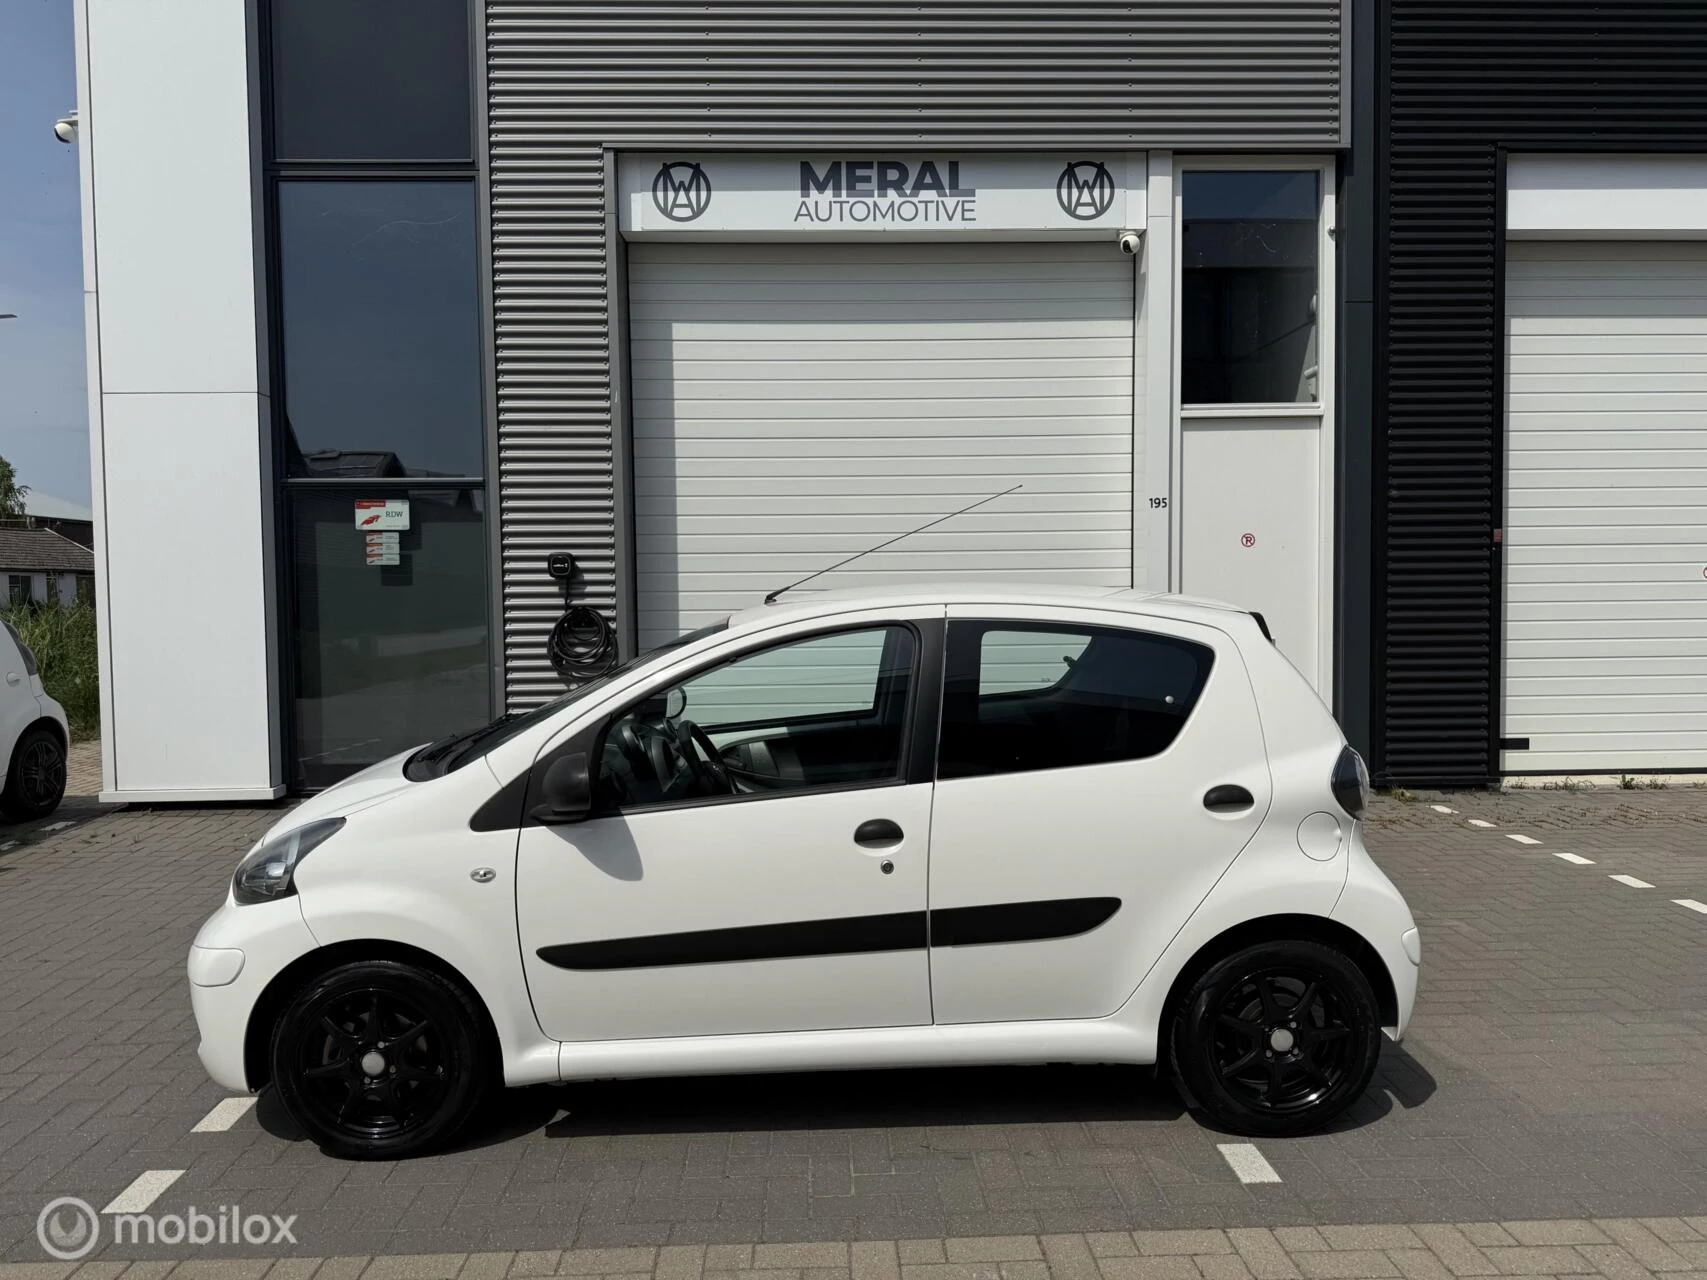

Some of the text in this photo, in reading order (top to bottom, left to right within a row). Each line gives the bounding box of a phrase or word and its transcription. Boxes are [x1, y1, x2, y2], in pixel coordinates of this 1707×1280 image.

[800, 161, 976, 198] MERAL
[793, 200, 977, 222] AUTOMOTIVE
[1149, 497, 1168, 508] 195
